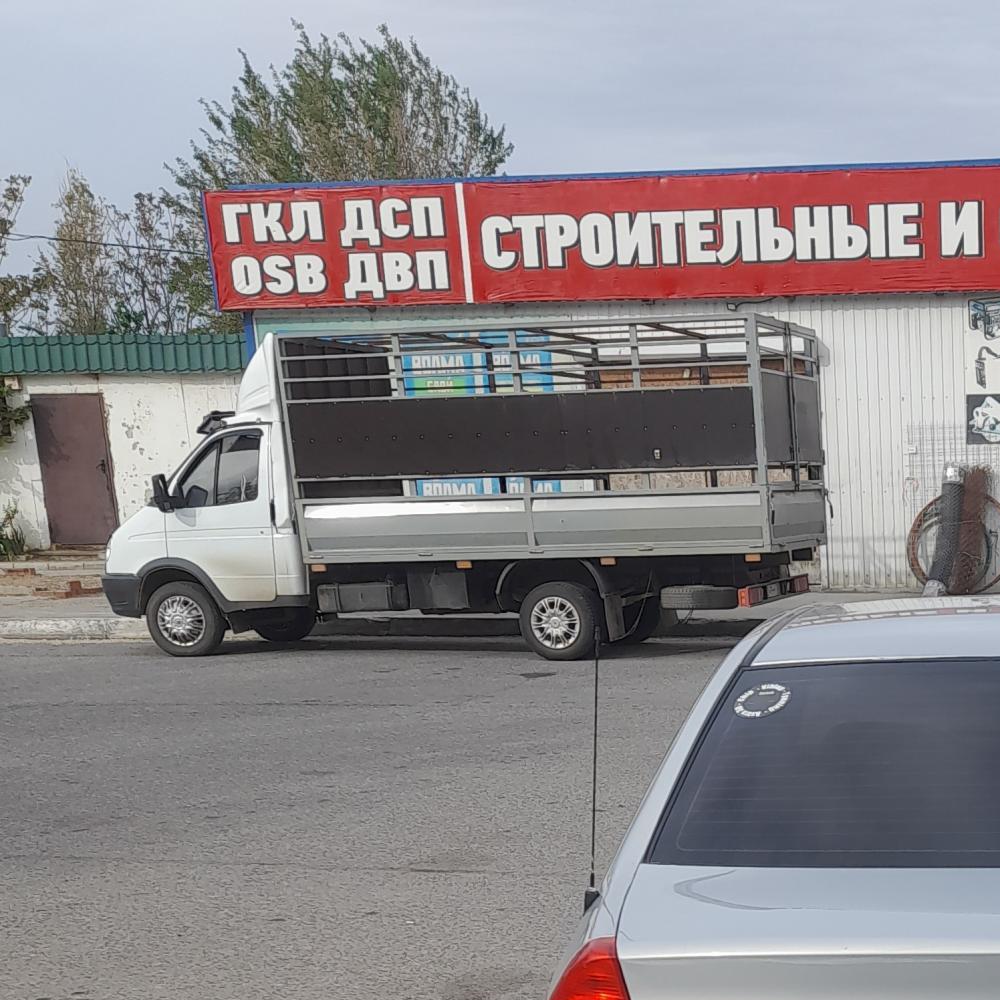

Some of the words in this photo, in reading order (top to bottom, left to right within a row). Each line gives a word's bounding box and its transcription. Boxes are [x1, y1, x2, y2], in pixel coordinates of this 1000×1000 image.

[220, 201, 325, 243] ГКЛ
[339, 196, 446, 248] ДСП
[480, 201, 923, 269] СТРОИТЕЛЬНЫЕ
[939, 201, 982, 258] И
[230, 254, 327, 295] OSB
[343, 250, 450, 300] ДВП
